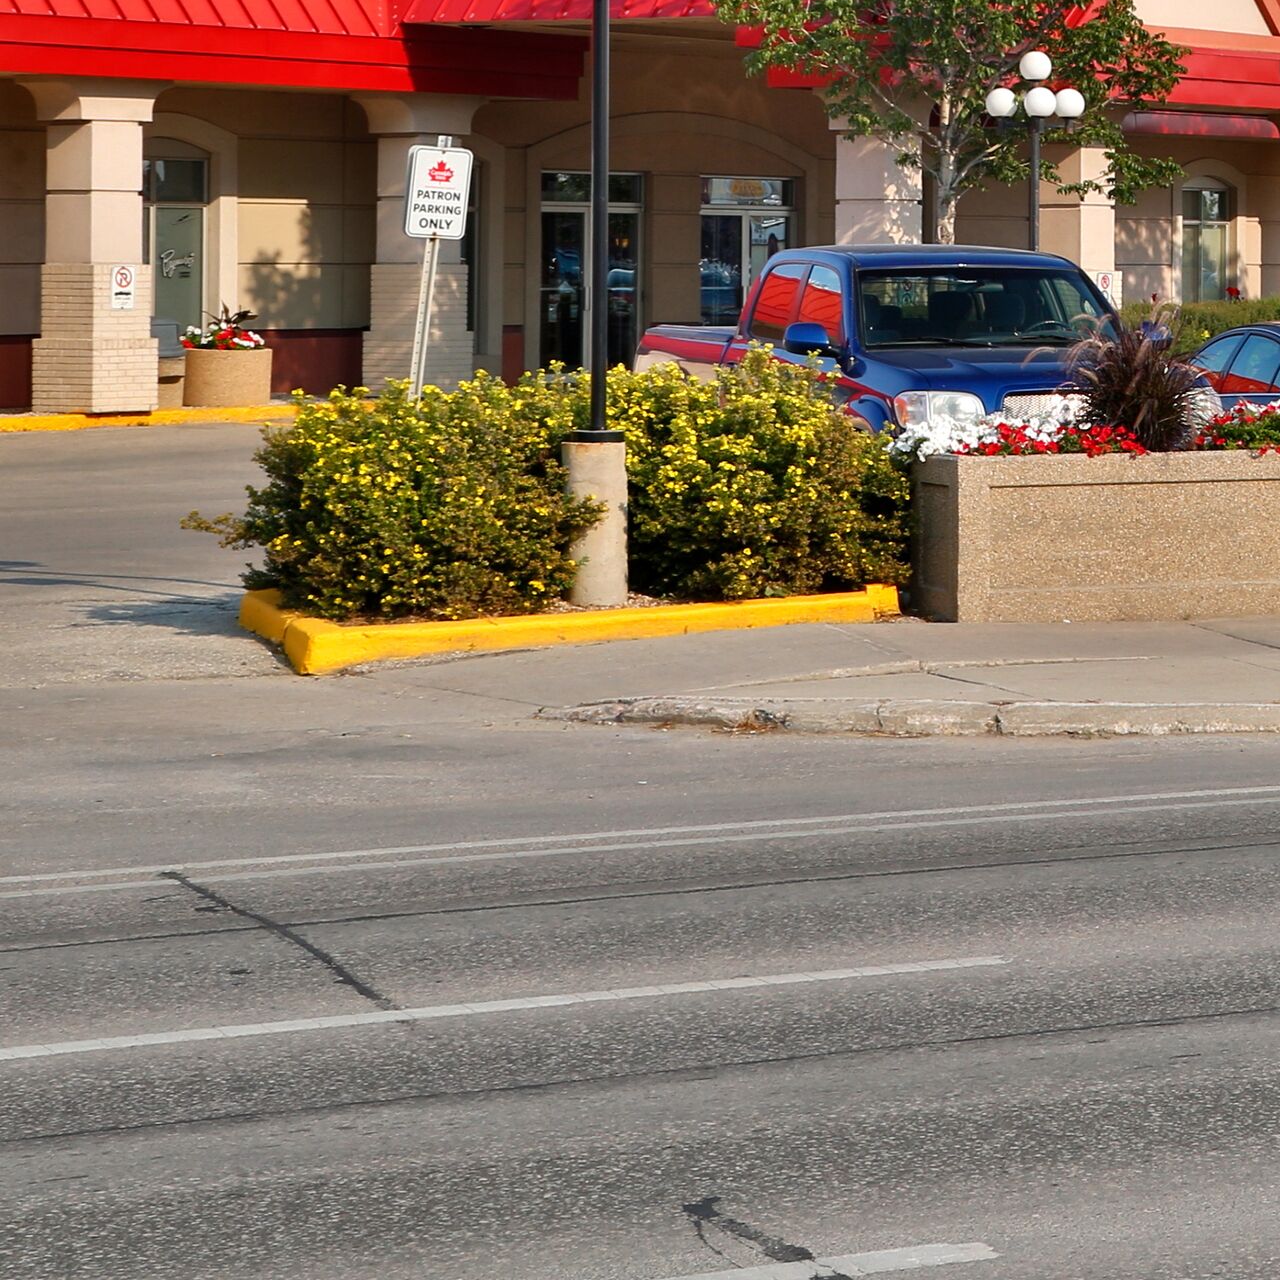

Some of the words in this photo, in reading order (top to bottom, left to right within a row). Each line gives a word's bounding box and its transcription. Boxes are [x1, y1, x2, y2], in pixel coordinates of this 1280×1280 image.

[417, 189, 462, 201] PATRON
[413, 203, 461, 216] PARKING
[419, 217, 453, 229] ONLY
